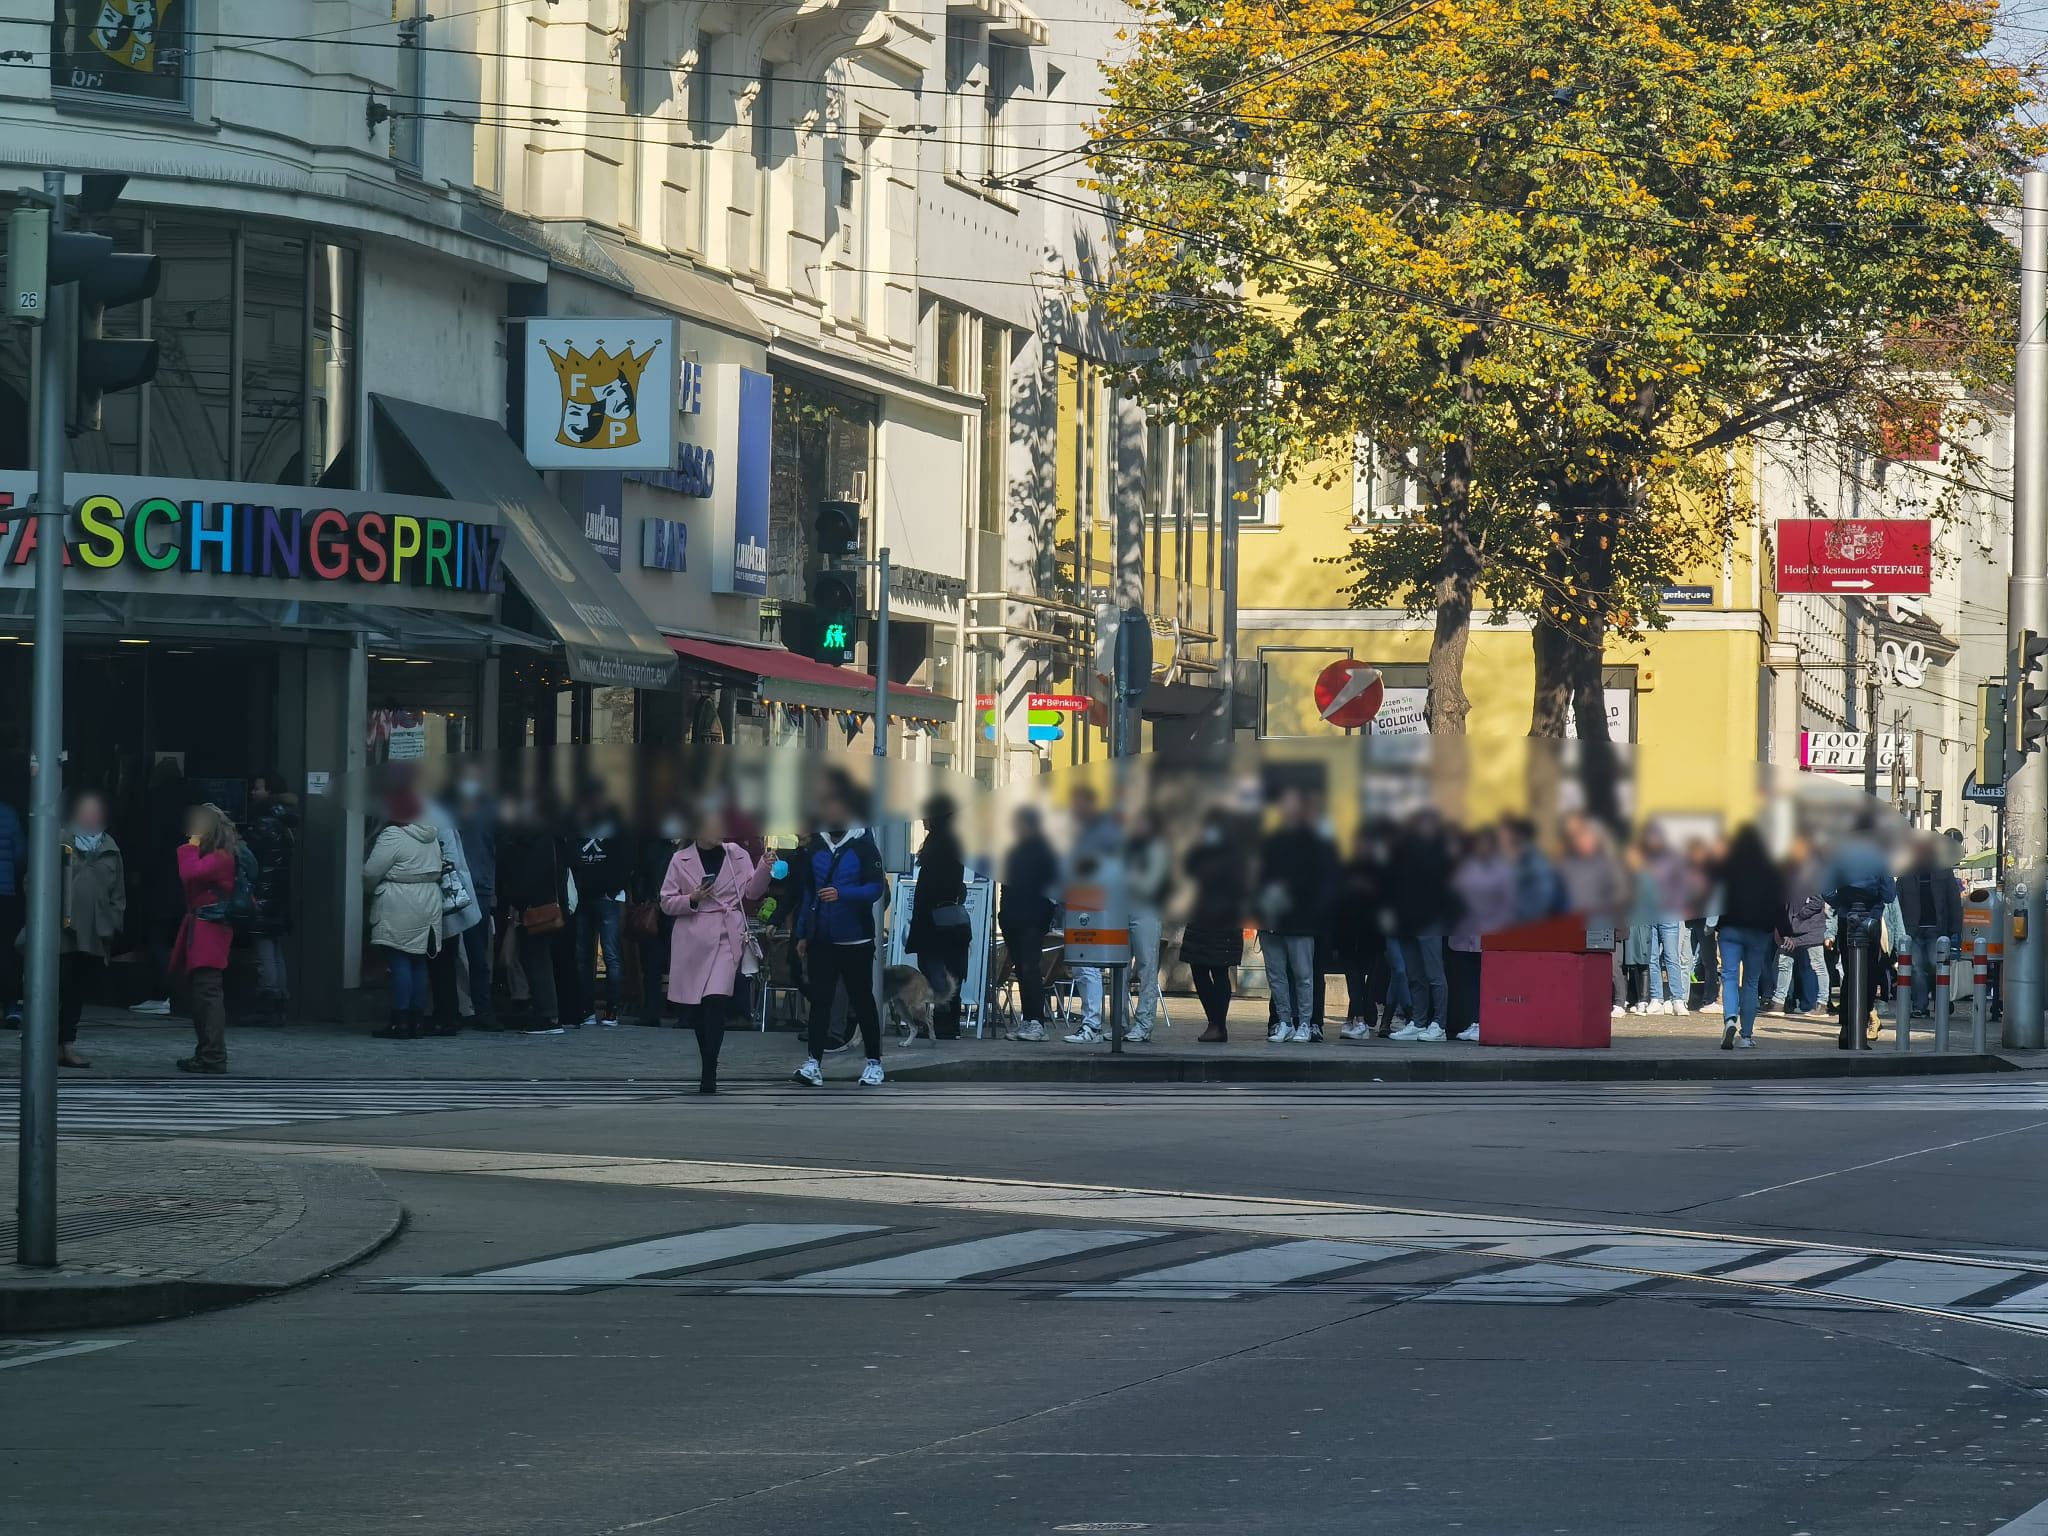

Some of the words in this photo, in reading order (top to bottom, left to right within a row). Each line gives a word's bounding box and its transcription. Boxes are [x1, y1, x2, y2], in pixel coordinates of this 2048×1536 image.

[21, 293, 37, 308] 26
[571, 373, 587, 397] F
[609, 422, 627, 444] P
[585, 504, 619, 545] LAVAZZA
[736, 535, 766, 572] LAVAZZA
[1784, 564, 1809, 574] Hotel
[1812, 565, 1820, 574] &
[1823, 564, 1869, 574] Restaurant
[1871, 564, 1924, 575] STEFANIE
[1382, 699, 1401, 708] tzen
[1811, 750, 1912, 766] FRIGE
[1972, 787, 2005, 796] HALTES
